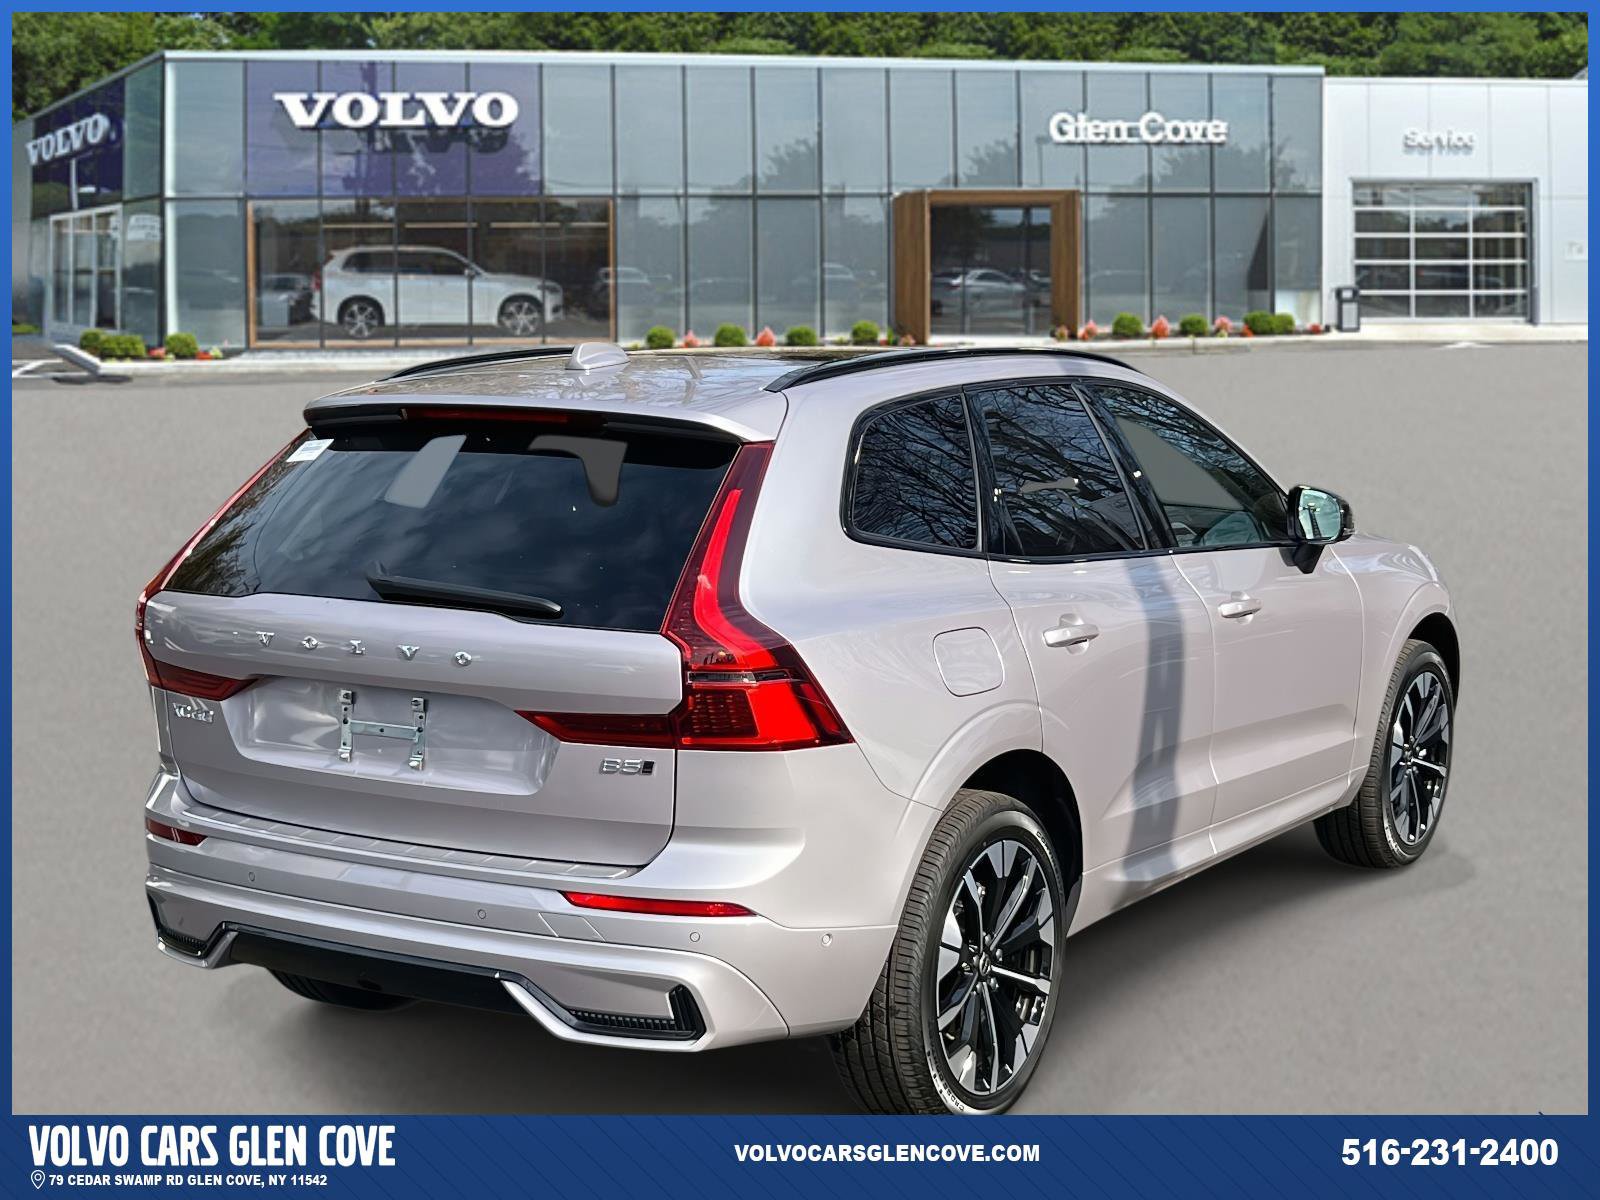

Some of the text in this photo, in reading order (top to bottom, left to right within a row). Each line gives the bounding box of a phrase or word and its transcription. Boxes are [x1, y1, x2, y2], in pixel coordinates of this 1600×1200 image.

[273, 92, 519, 128] VOLVO
[1049, 112, 1228, 143] Glen Cove
[25, 112, 111, 166] VOLVO
[255, 630, 472, 667] VOLVO
